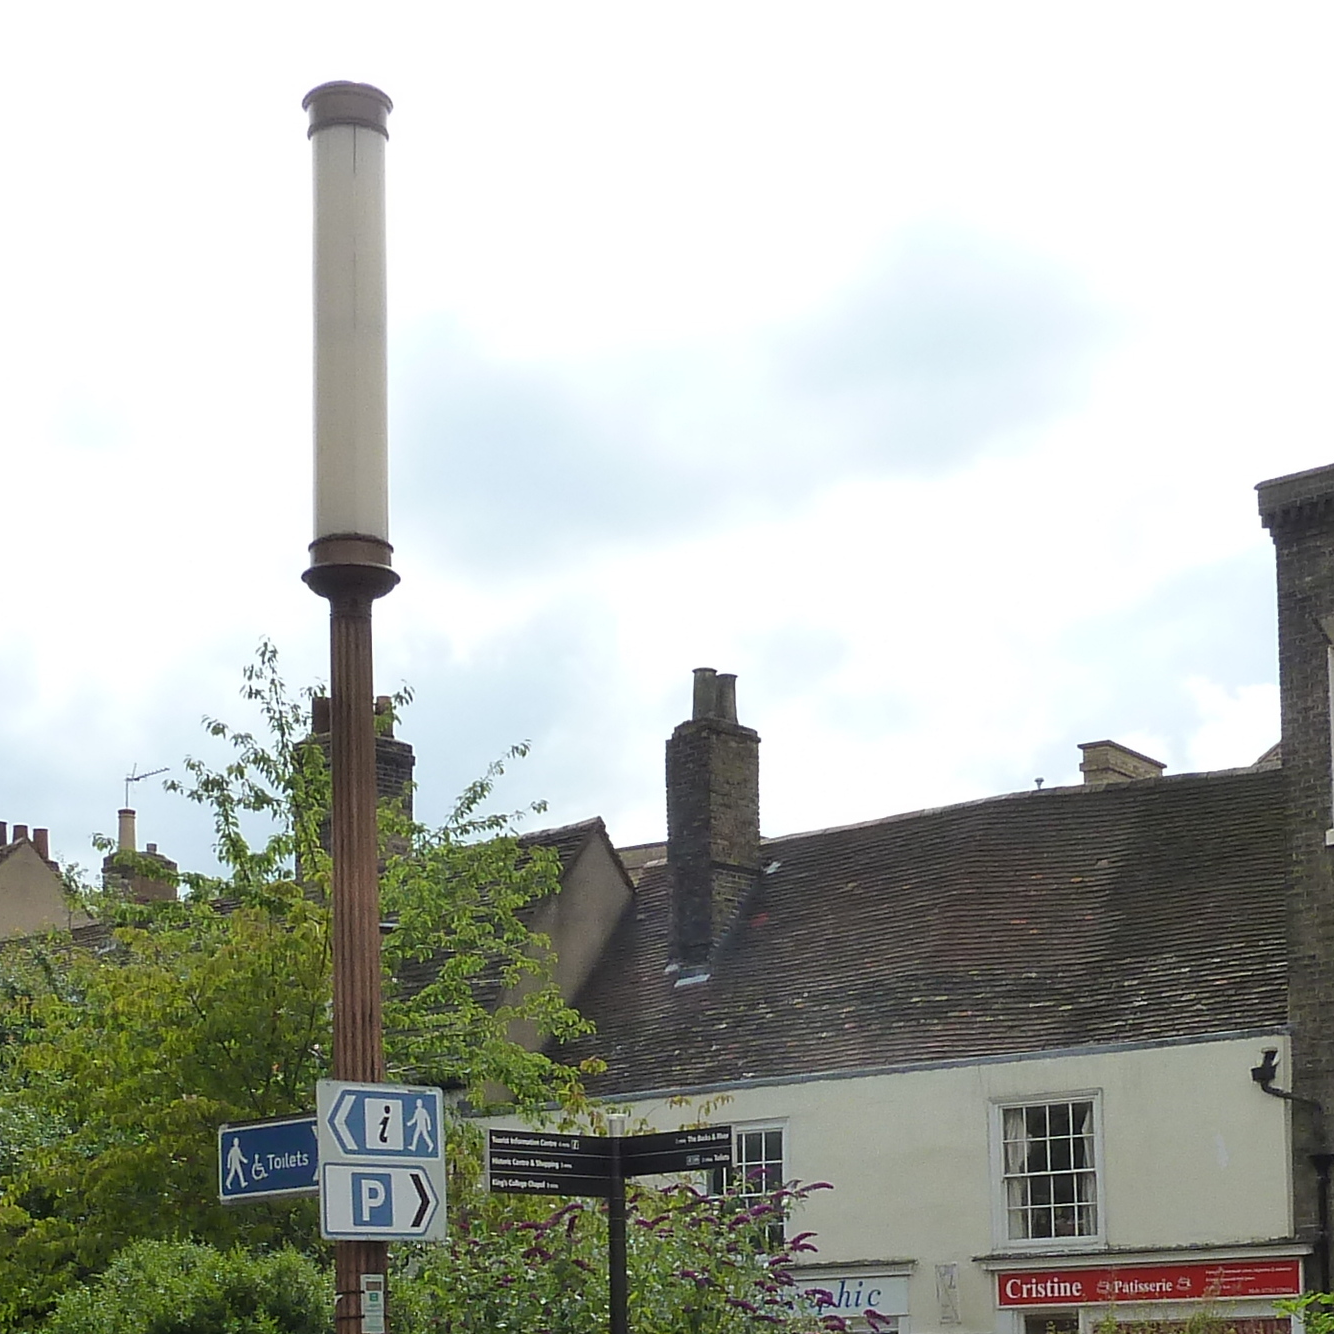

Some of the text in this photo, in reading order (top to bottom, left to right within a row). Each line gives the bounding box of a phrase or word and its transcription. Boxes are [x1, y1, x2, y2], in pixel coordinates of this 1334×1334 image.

[267, 1151, 309, 1171] Toilets
[361, 1179, 386, 1221] P
[1005, 1277, 1083, 1299] Cristine
[1114, 1278, 1173, 1294] Patisserie
